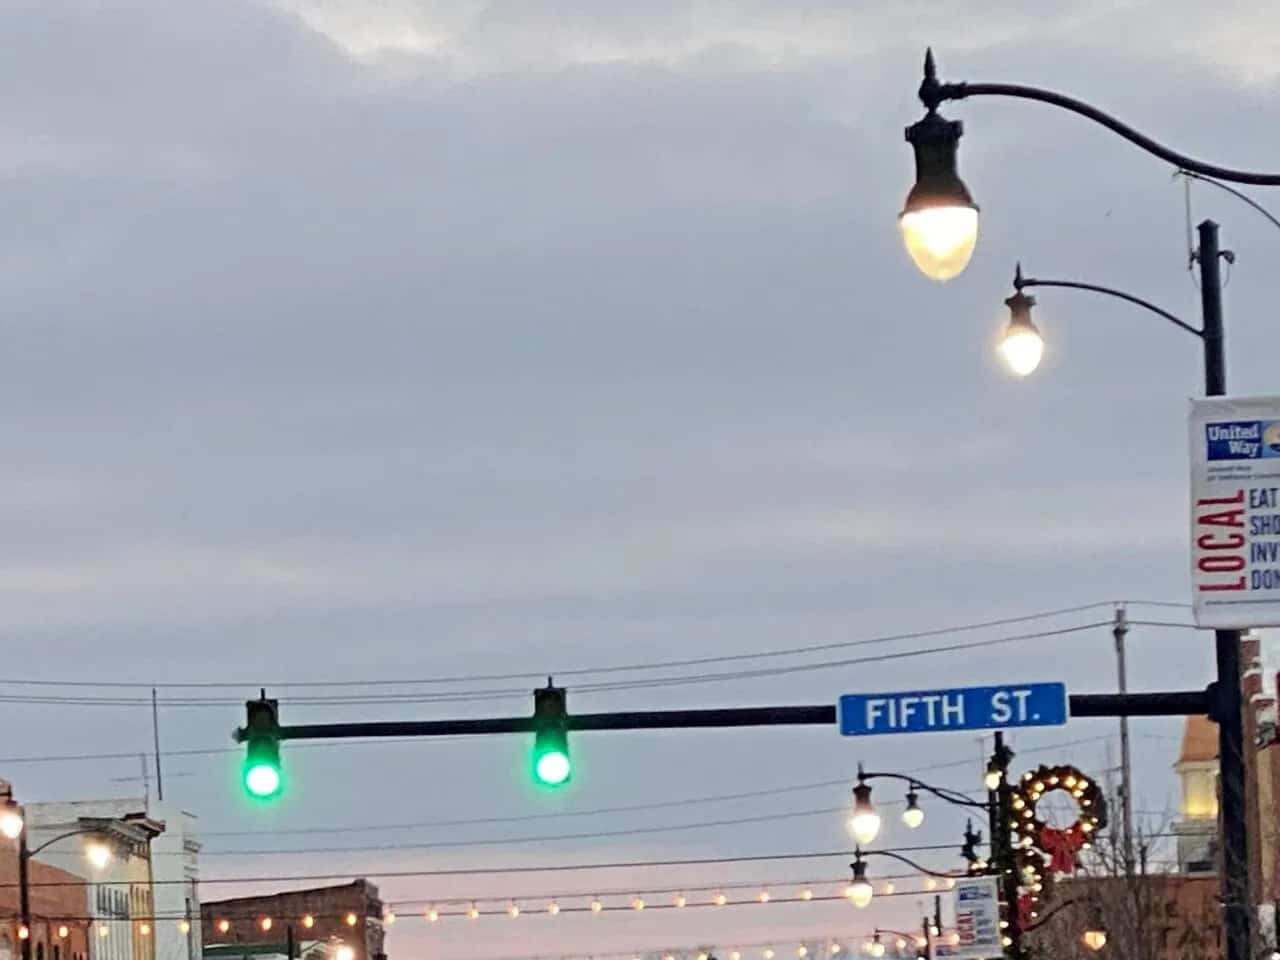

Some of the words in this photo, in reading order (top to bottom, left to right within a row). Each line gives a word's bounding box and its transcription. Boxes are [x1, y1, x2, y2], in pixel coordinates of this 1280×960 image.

[1208, 425, 1258, 440] United
[1228, 441, 1260, 457] Way
[1249, 487, 1279, 508] EAT
[1197, 490, 1246, 591] LOCAL
[866, 694, 965, 729] FIFTH
[991, 690, 1040, 723] ST.
